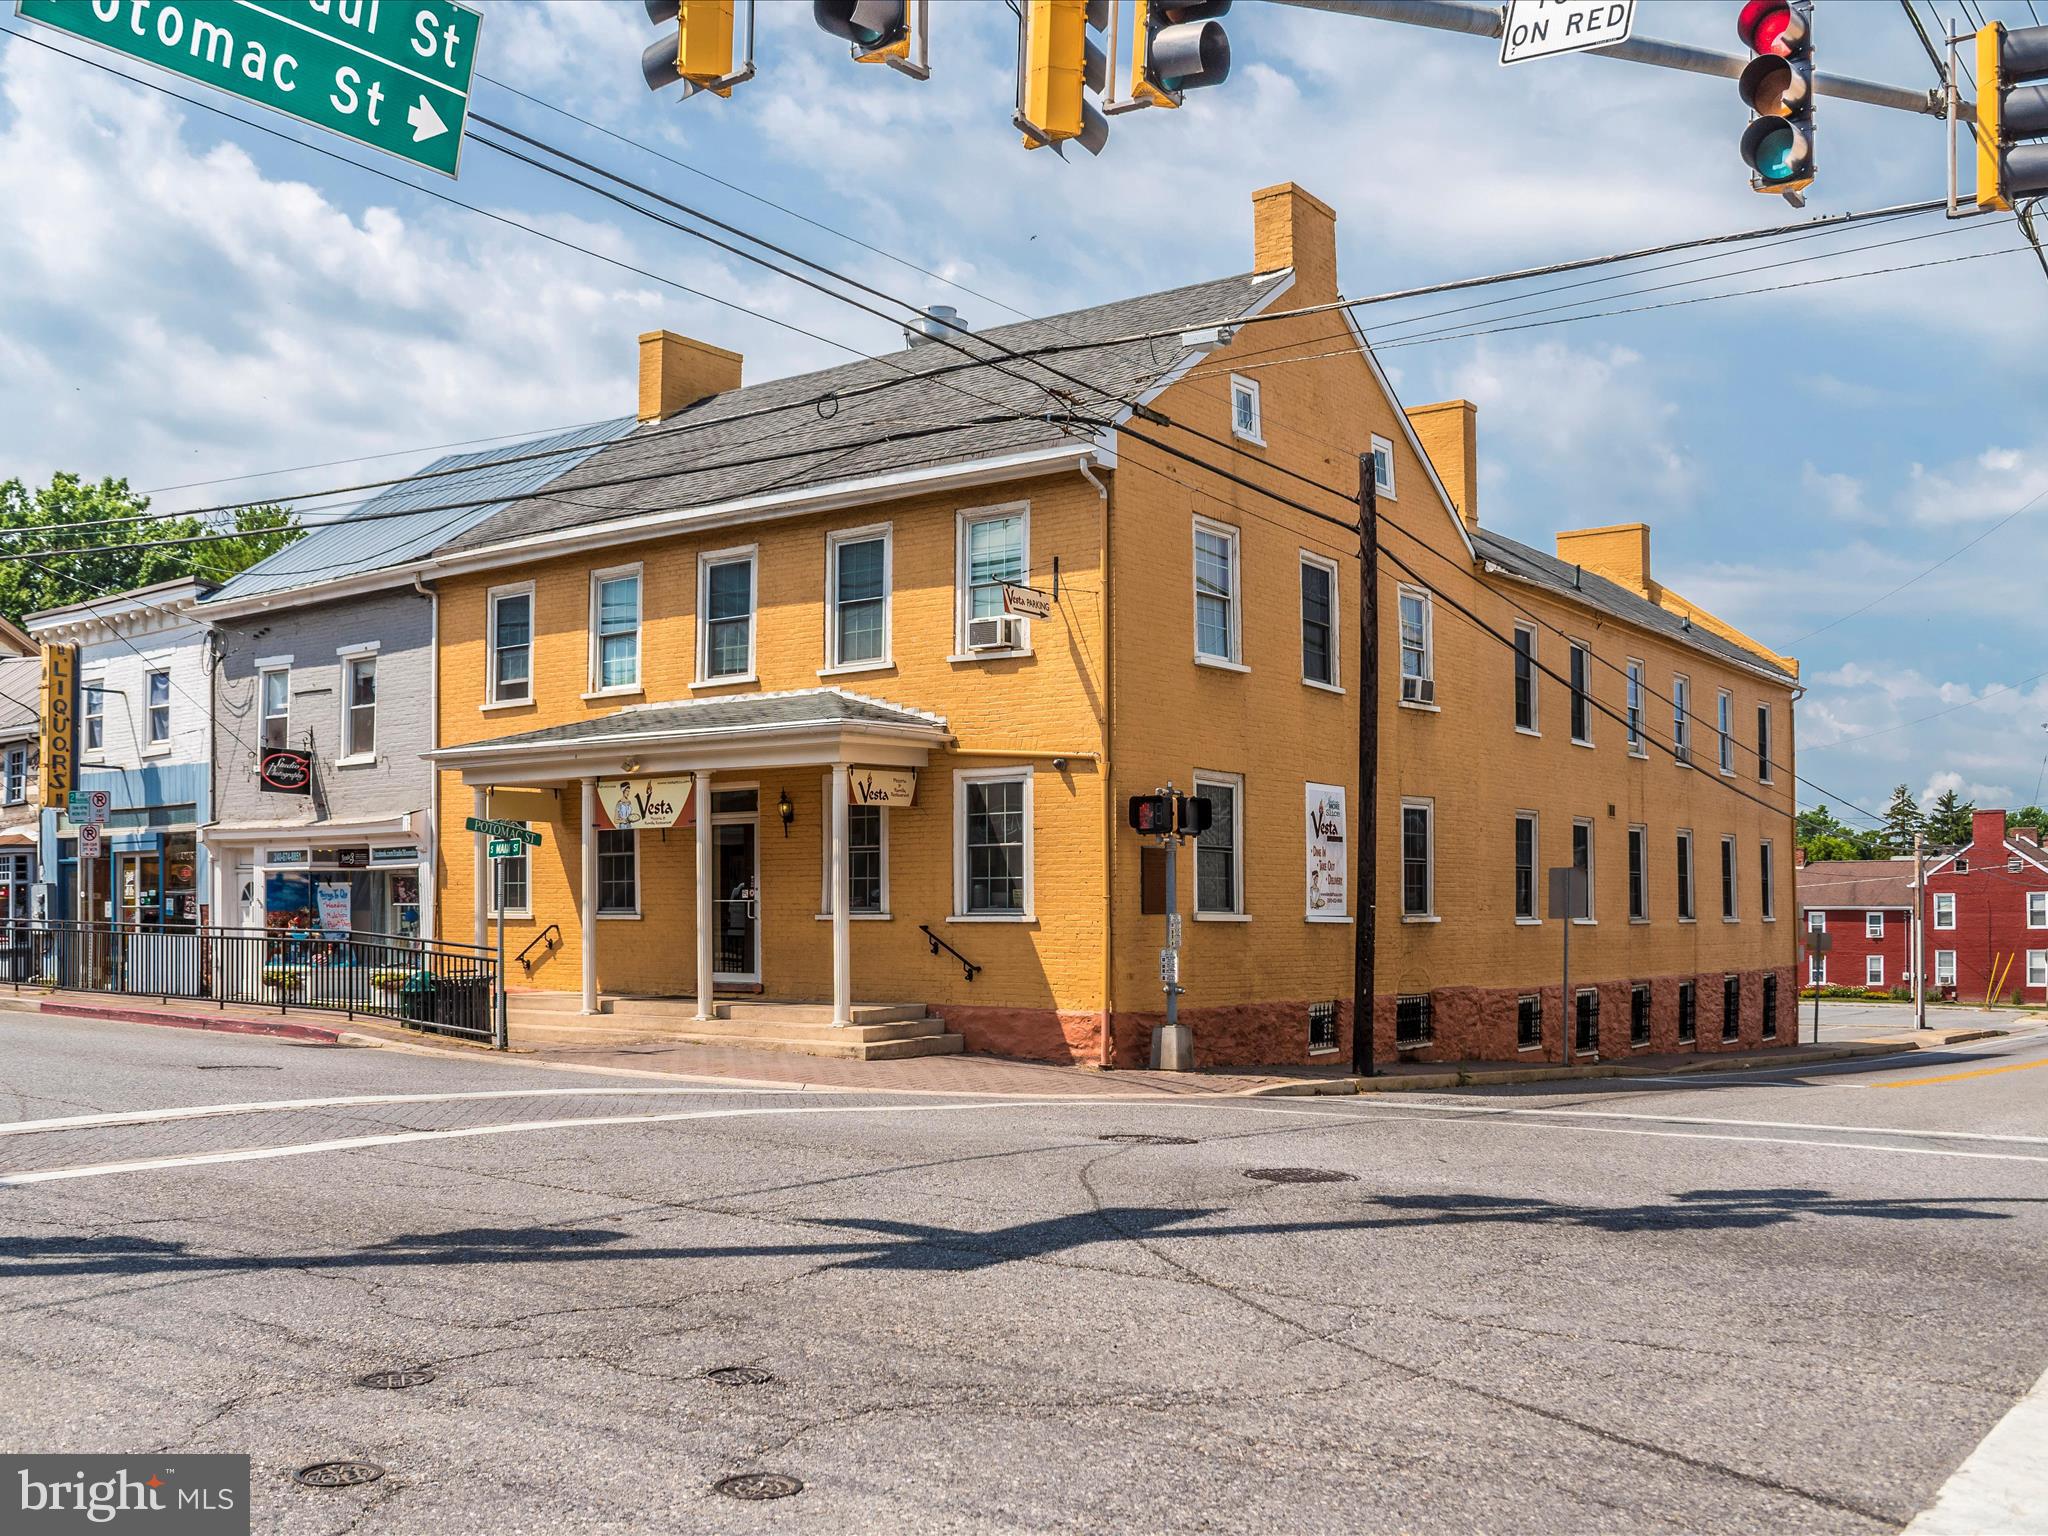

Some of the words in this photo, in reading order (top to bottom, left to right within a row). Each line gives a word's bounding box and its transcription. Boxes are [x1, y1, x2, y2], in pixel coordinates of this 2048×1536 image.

[411, 10, 460, 69] St
[1512, 19, 1549, 46] ON
[1566, 4, 1625, 36] RED
[47, 0, 299, 92] otomac
[330, 66, 385, 127] St
[1005, 588, 1025, 605] Vesta
[1026, 598, 1050, 611] PARKING
[634, 791, 673, 820] Vesta
[858, 780, 889, 804] Vesta
[474, 820, 522, 839] POTOMAC
[525, 832, 536, 843] ST
[1310, 810, 1338, 839] Vesta
[490, 845, 494, 854] S
[496, 843, 511, 854] MAIN
[513, 843, 519, 852] ST
